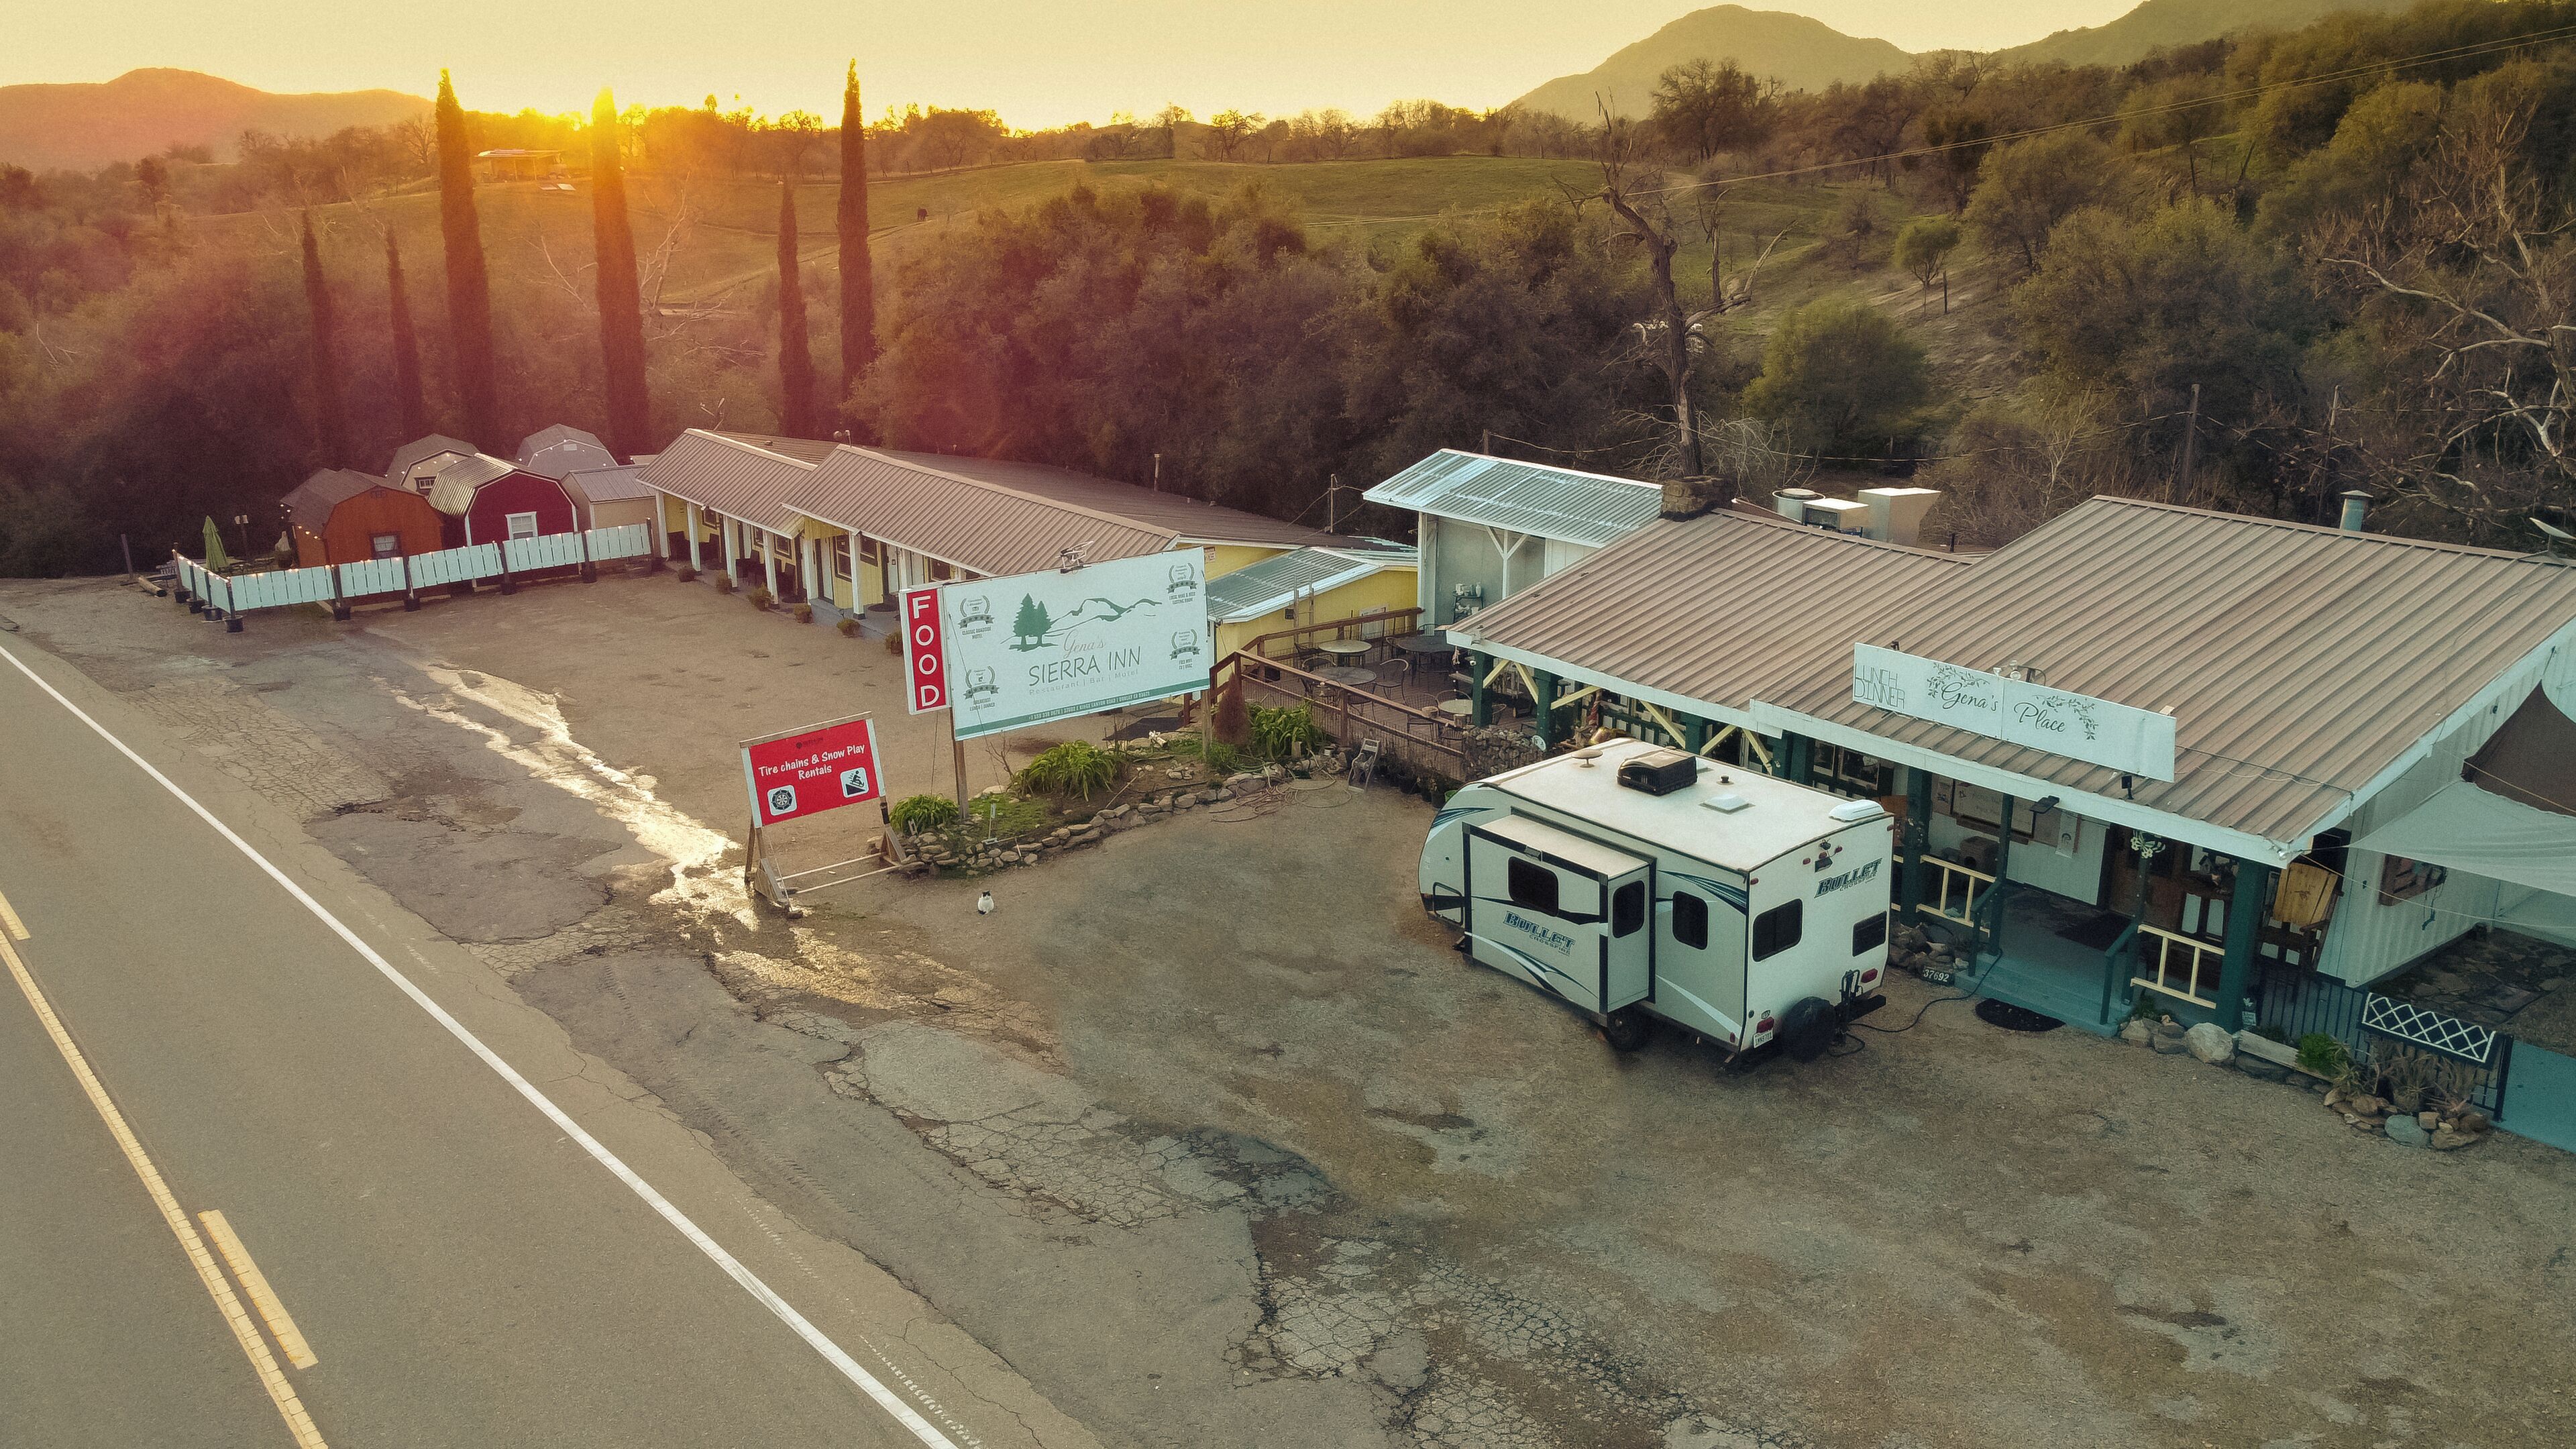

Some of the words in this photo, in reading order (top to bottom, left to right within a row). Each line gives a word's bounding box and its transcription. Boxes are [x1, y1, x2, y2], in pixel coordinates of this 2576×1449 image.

[912, 596, 939, 707] FOOD
[1063, 629, 1106, 659] Gena's
[1029, 655, 1101, 686] SIERRA
[1109, 646, 1141, 670] INN
[1855, 663, 1898, 689] LUNCH
[1030, 681, 1079, 696] Restaurant
[1115, 669, 1138, 679] Motel
[1854, 677, 1905, 709] DINNER
[1941, 681, 1999, 712] Gena's
[2013, 702, 2066, 733] Place
[758, 765, 778, 777] Tire
[781, 758, 809, 771] chains
[812, 754, 820, 765] &
[822, 749, 845, 763] Snow
[847, 744, 865, 756] Play
[798, 765, 832, 780] Rentals
[1814, 858, 1883, 898] BULLET
[1503, 910, 1576, 951] BULLET
[1529, 934, 1570, 955] CROSSFIRE
[1923, 969, 1949, 982] 37692
